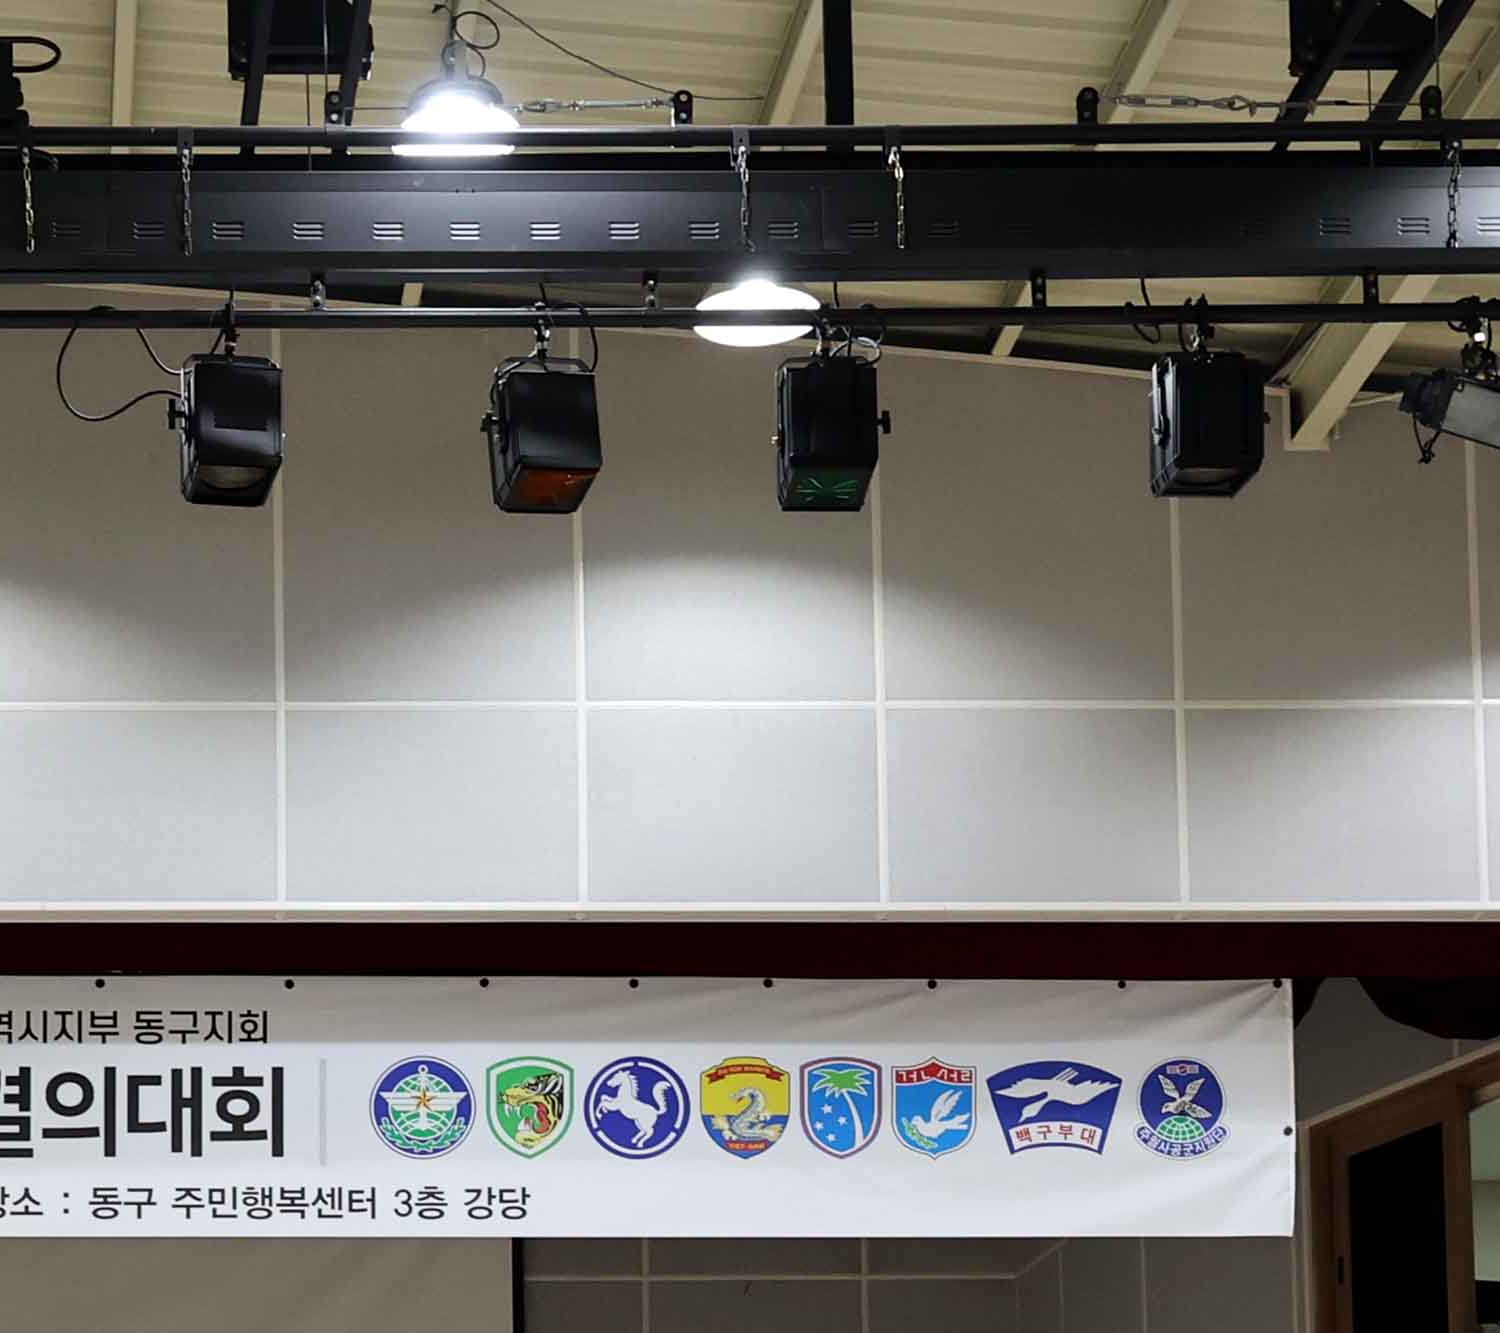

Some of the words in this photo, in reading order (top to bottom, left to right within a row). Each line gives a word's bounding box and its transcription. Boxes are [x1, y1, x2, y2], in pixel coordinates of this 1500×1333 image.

[133, 1009, 268, 1045] 동구지회
[1015, 1123, 1097, 1146] 백구부대
[88, 1187, 157, 1220] 동구
[171, 1186, 376, 1220] 주민행복센터
[394, 1186, 449, 1220] 3층
[464, 1186, 531, 1220] 강당
